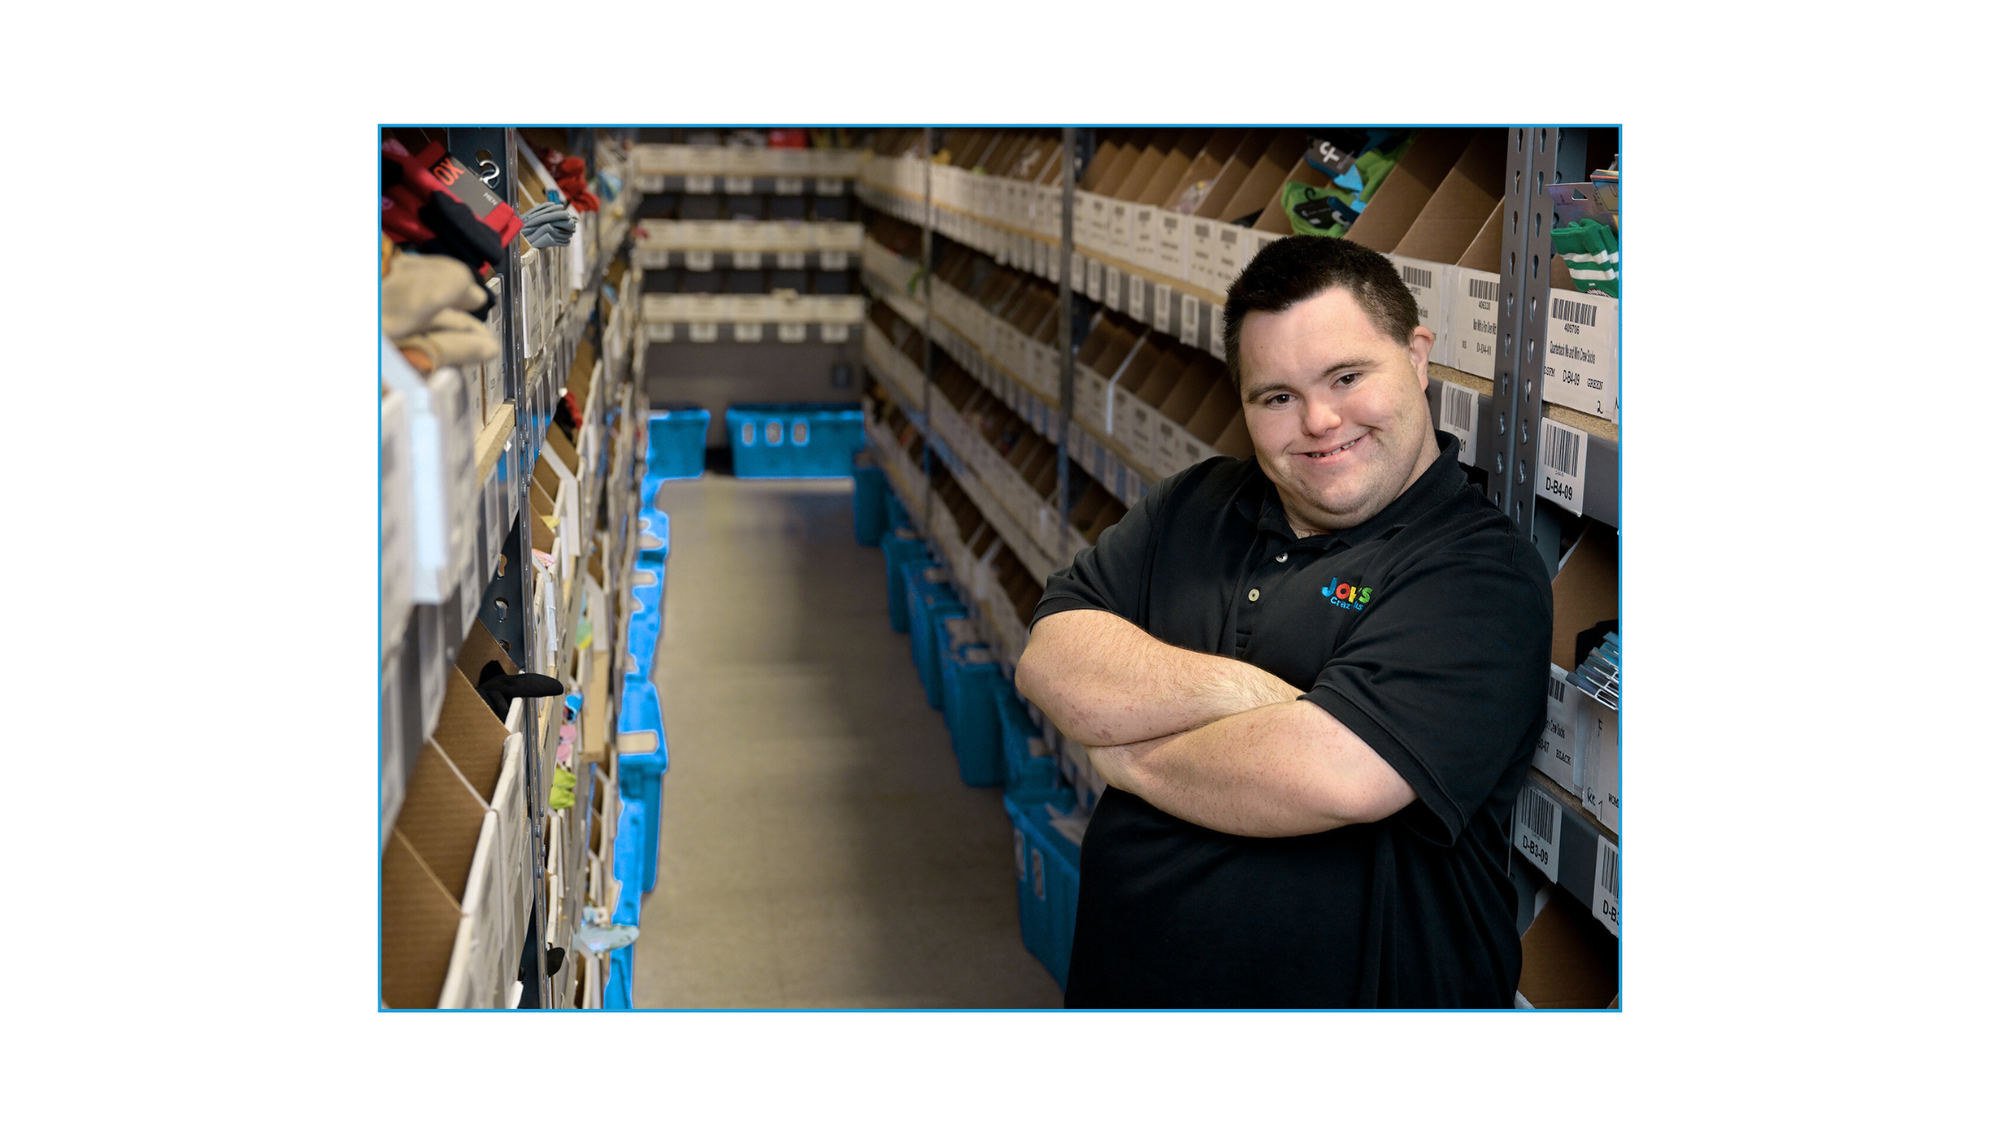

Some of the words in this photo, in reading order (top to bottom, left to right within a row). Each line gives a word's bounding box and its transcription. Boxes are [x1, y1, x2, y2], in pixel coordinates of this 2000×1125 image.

[483, 192, 498, 206] MEN
[1546, 476, 1573, 501] D-B4-09
[1330, 596, 1352, 610] Craz
[1555, 749, 1571, 766] BLACK
[1523, 835, 1548, 865] D-B3-09
